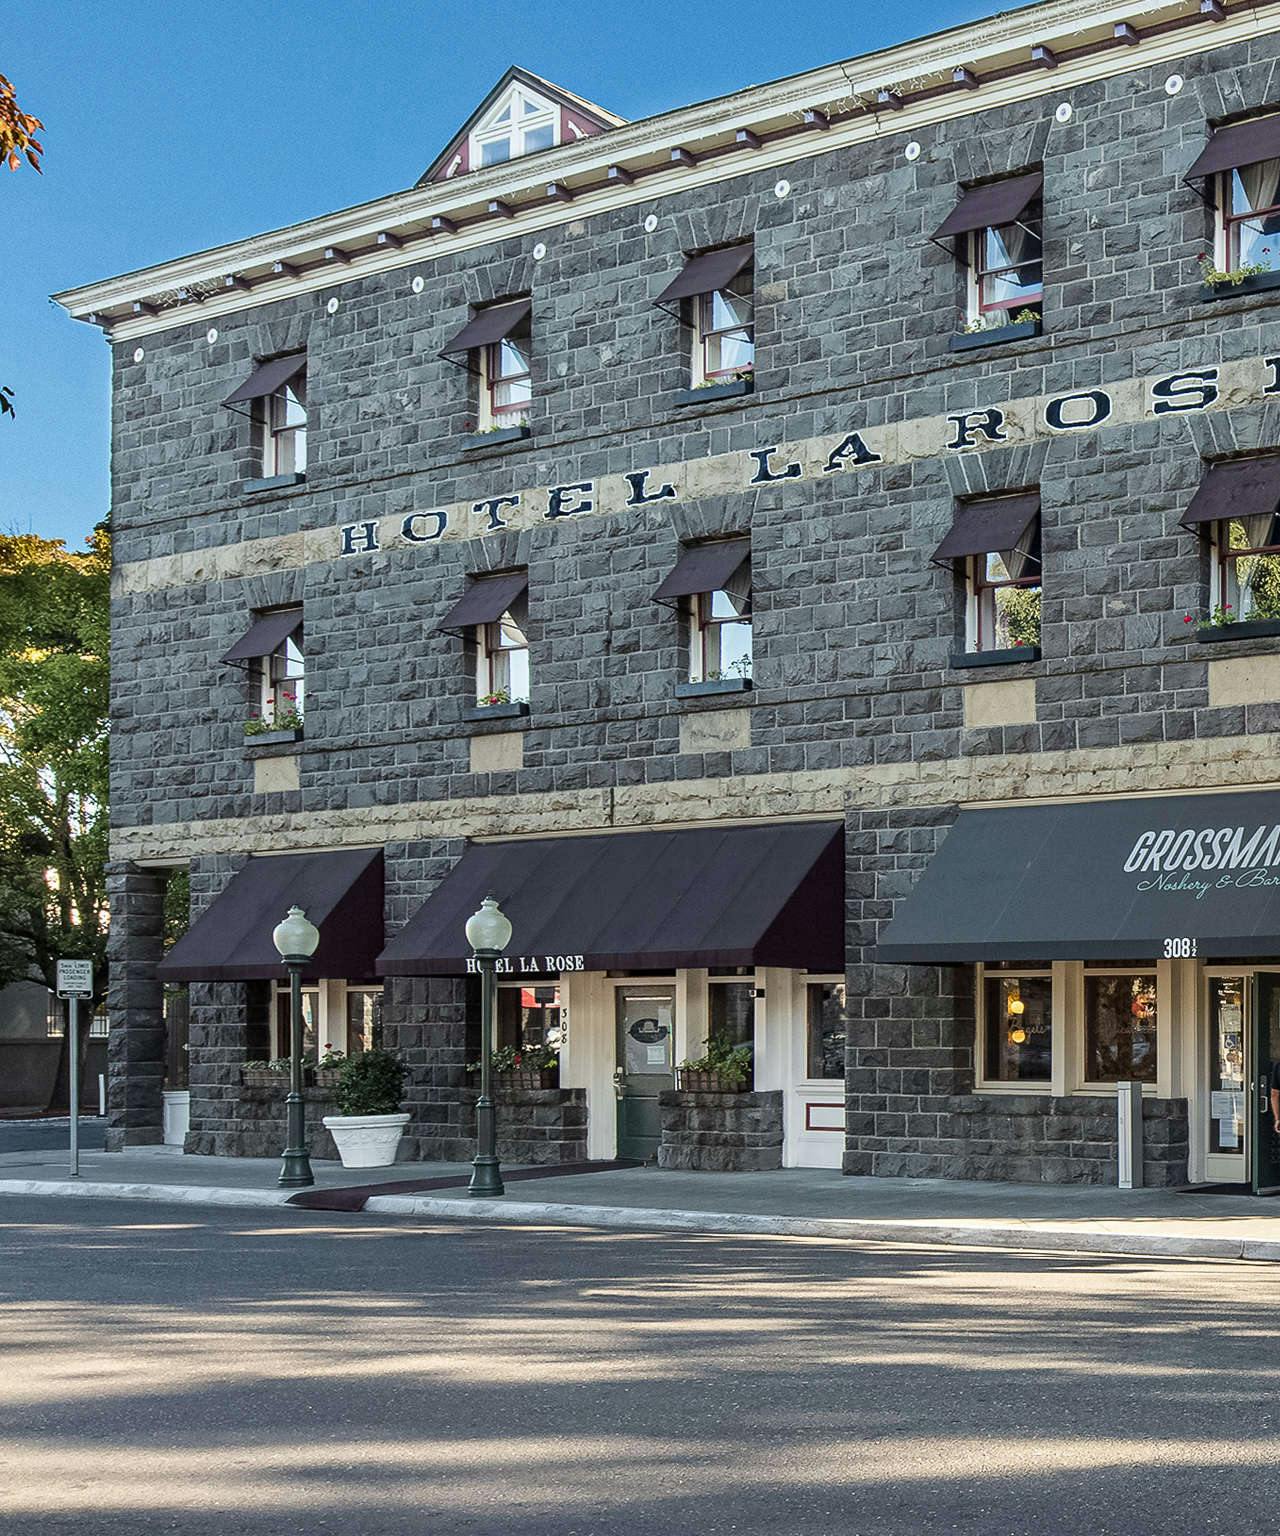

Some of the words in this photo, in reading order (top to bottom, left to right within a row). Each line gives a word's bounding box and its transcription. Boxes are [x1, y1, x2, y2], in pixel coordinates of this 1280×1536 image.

[340, 470, 676, 557] HOTEL
[749, 430, 883, 486] LA
[1136, 871, 1212, 900] Noshery
[1215, 874, 1234, 889] &
[465, 957, 514, 973] HEL
[519, 956, 540, 972] LA
[544, 954, 585, 971] ROSE
